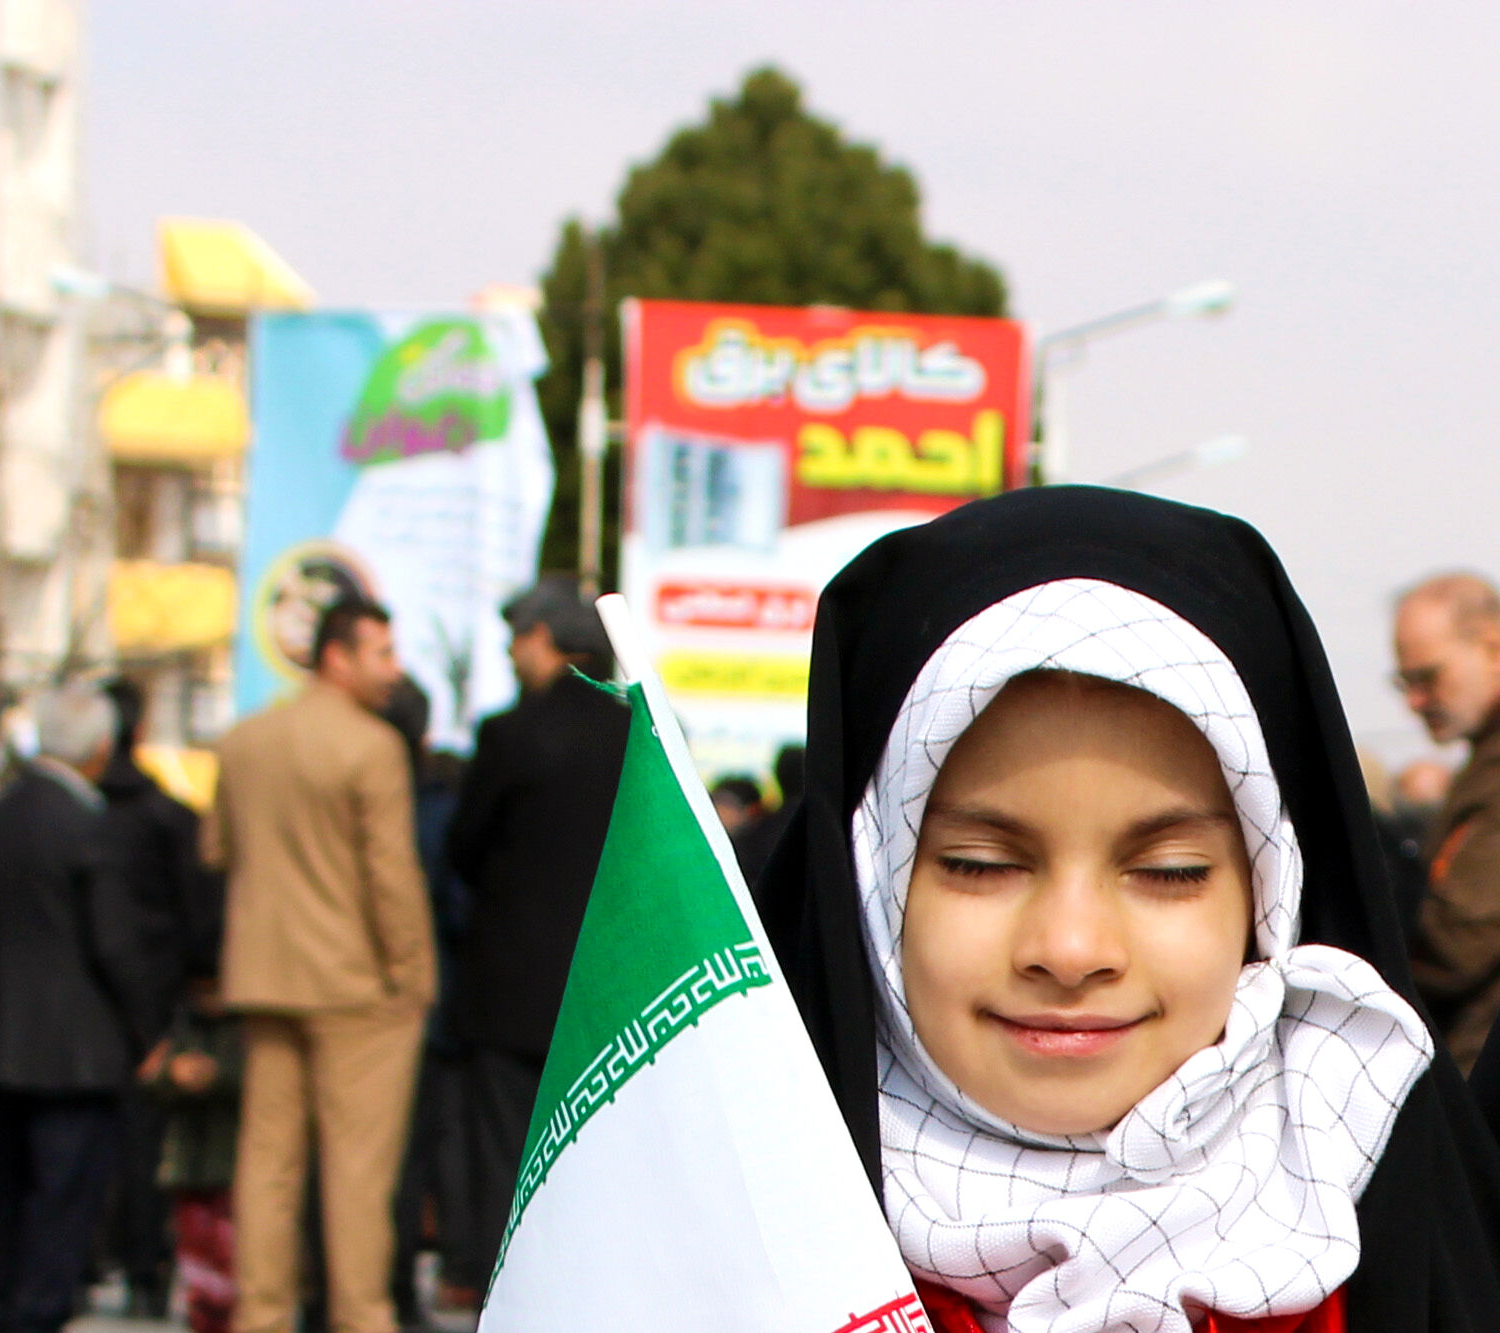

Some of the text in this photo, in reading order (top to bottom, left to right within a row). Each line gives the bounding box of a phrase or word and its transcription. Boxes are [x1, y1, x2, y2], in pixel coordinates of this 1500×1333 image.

[681, 326, 987, 416] کالای برق
[797, 408, 1005, 495] احمد
